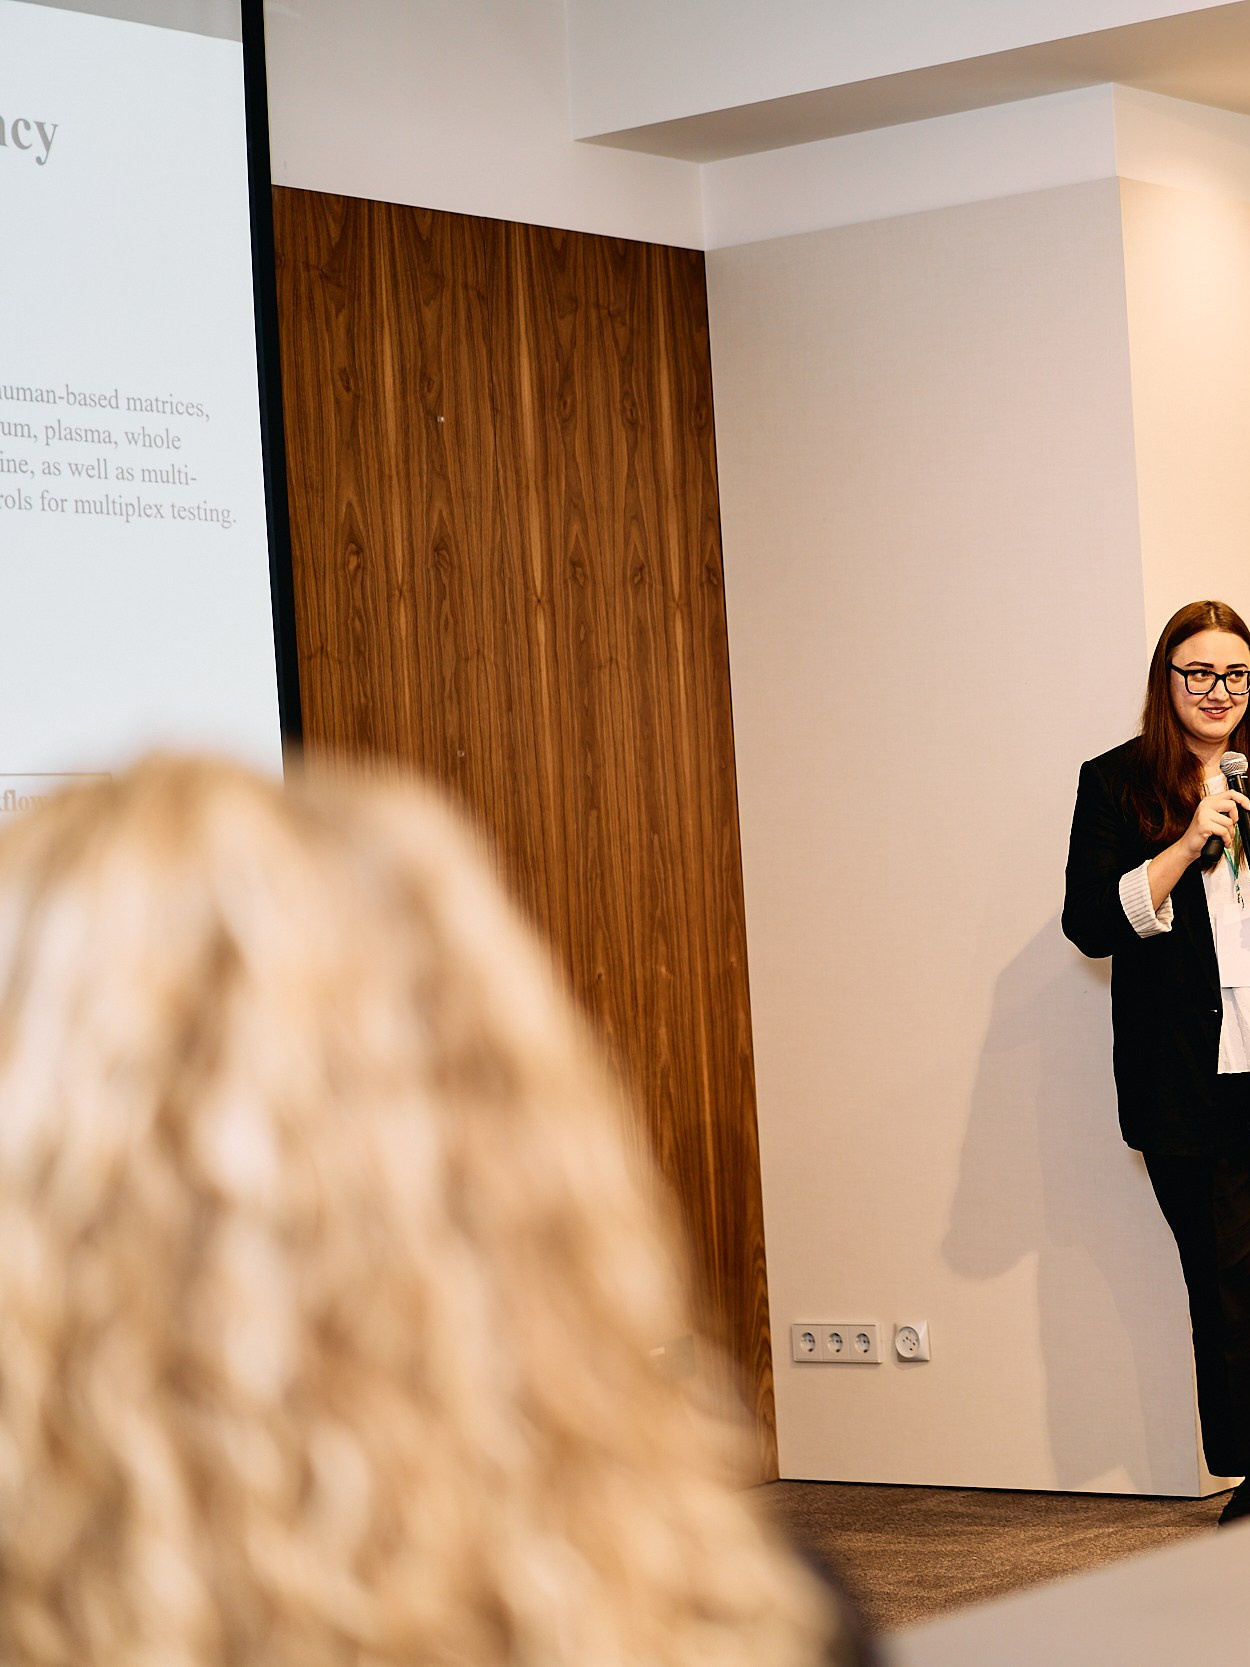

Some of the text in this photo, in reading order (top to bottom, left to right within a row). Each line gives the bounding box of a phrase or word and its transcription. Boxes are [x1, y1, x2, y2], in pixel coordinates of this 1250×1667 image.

[0, 384, 210, 421] uman-based matrices,
[44, 419, 119, 449] plasma,
[124, 426, 182, 450] whole
[41, 459, 62, 477] as
[68, 458, 109, 480] well
[115, 465, 135, 482] as
[141, 463, 197, 486] multi-
[40, 489, 68, 513] for
[74, 494, 165, 524] multiplex
[171, 500, 237, 529] testing.
